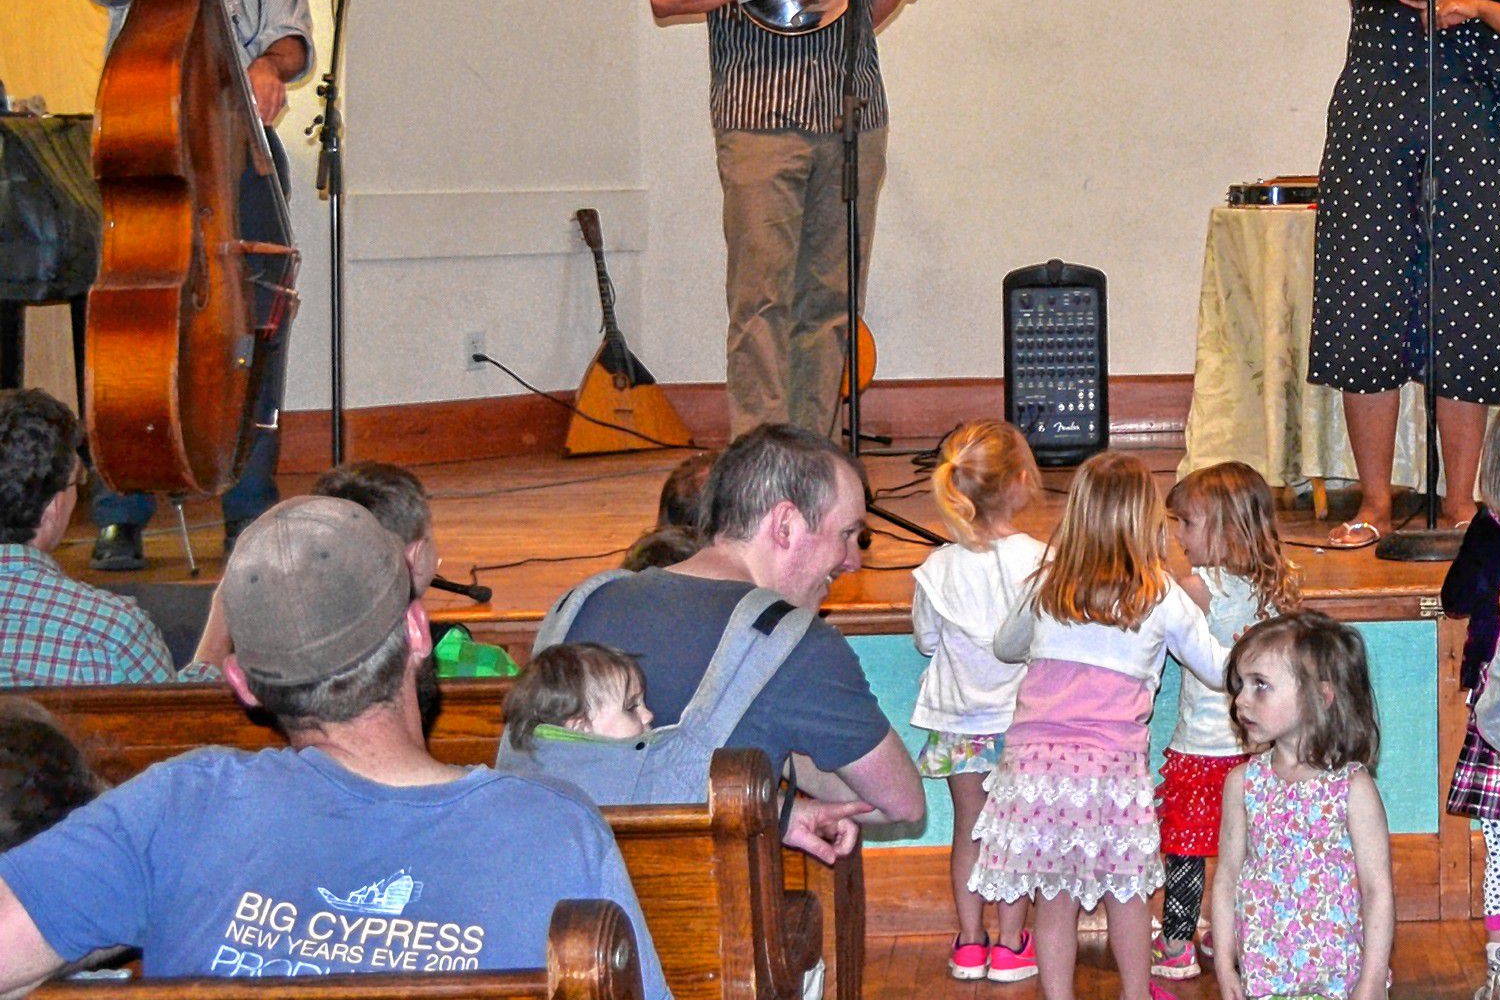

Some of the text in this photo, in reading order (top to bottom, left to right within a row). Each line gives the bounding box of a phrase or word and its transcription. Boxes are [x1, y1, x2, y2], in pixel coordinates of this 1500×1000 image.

[225, 920, 479, 972] NEW YEARS EVE 2000
[235, 891, 485, 955] BIG CYPRESS
